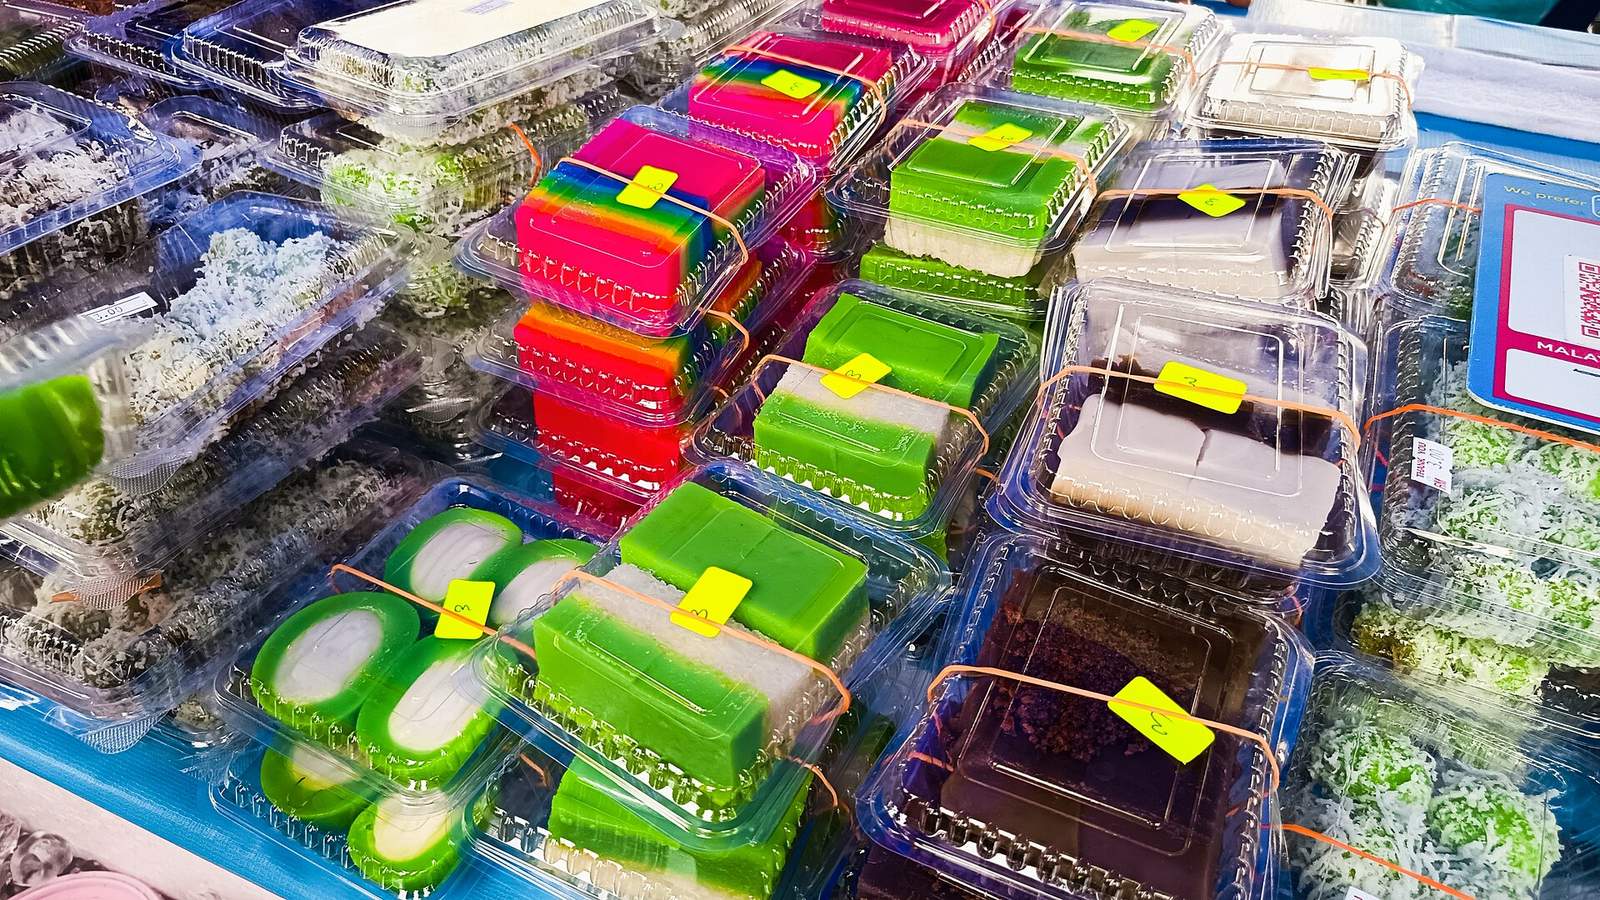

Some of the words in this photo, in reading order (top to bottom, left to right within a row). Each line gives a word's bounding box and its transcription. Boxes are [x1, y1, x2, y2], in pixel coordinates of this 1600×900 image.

[1503, 185, 1531, 196] We
[1535, 193, 1587, 207] prefer
[1536, 341, 1600, 363] MALA
[1417, 441, 1427, 455] YOU
[1416, 456, 1426, 478] THANK
[1433, 477, 1447, 491] RM
